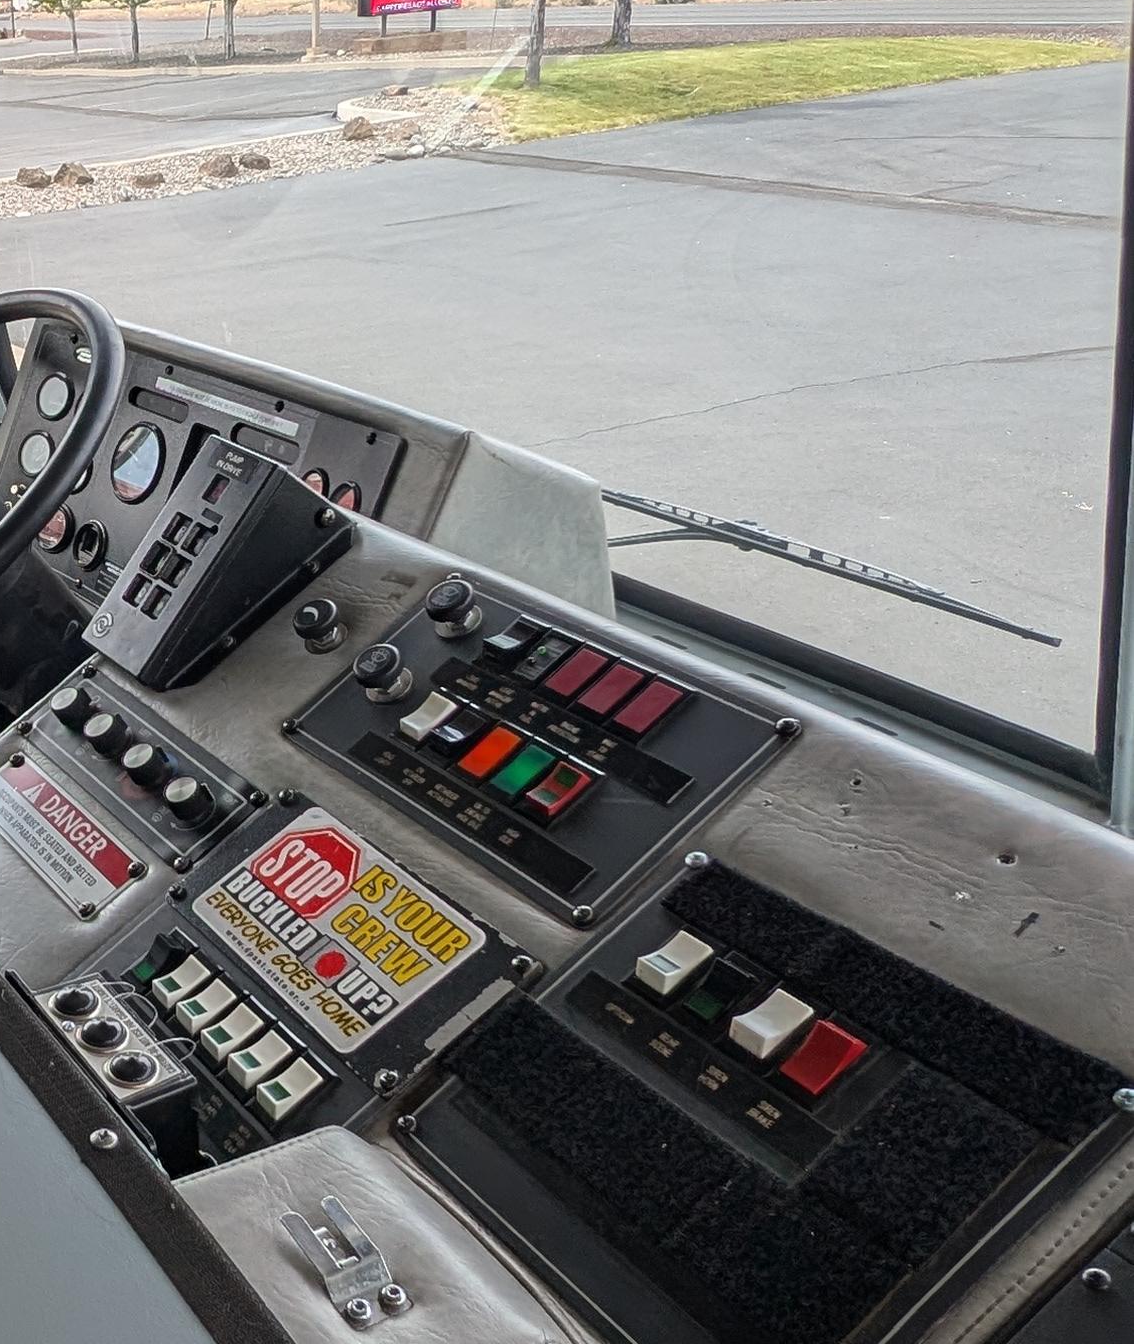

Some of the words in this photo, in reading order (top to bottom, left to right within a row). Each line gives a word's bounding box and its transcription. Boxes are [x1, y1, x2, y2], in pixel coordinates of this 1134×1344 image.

[10, 818, 42, 851] APPARATUS
[37, 844, 47, 856] IS
[44, 851, 54, 863] IN
[49, 858, 74, 884] MOTION
[23, 811, 39, 828] MUST
[36, 824, 47, 837] BE
[43, 831, 66, 855] SEATED
[61, 850, 77, 866] AND
[73, 862, 97, 887] BELTED
[40, 794, 107, 860] DANGER
[226, 870, 318, 951] BUCKLED
[337, 969, 394, 1017] UP?
[259, 838, 345, 907] STOP
[351, 864, 398, 904] IS
[380, 885, 472, 965] YOUR
[206, 891, 279, 955] EVERYONE
[271, 953, 317, 991] GOES
[312, 989, 367, 1038] HOME
[331, 903, 433, 987] CREW
